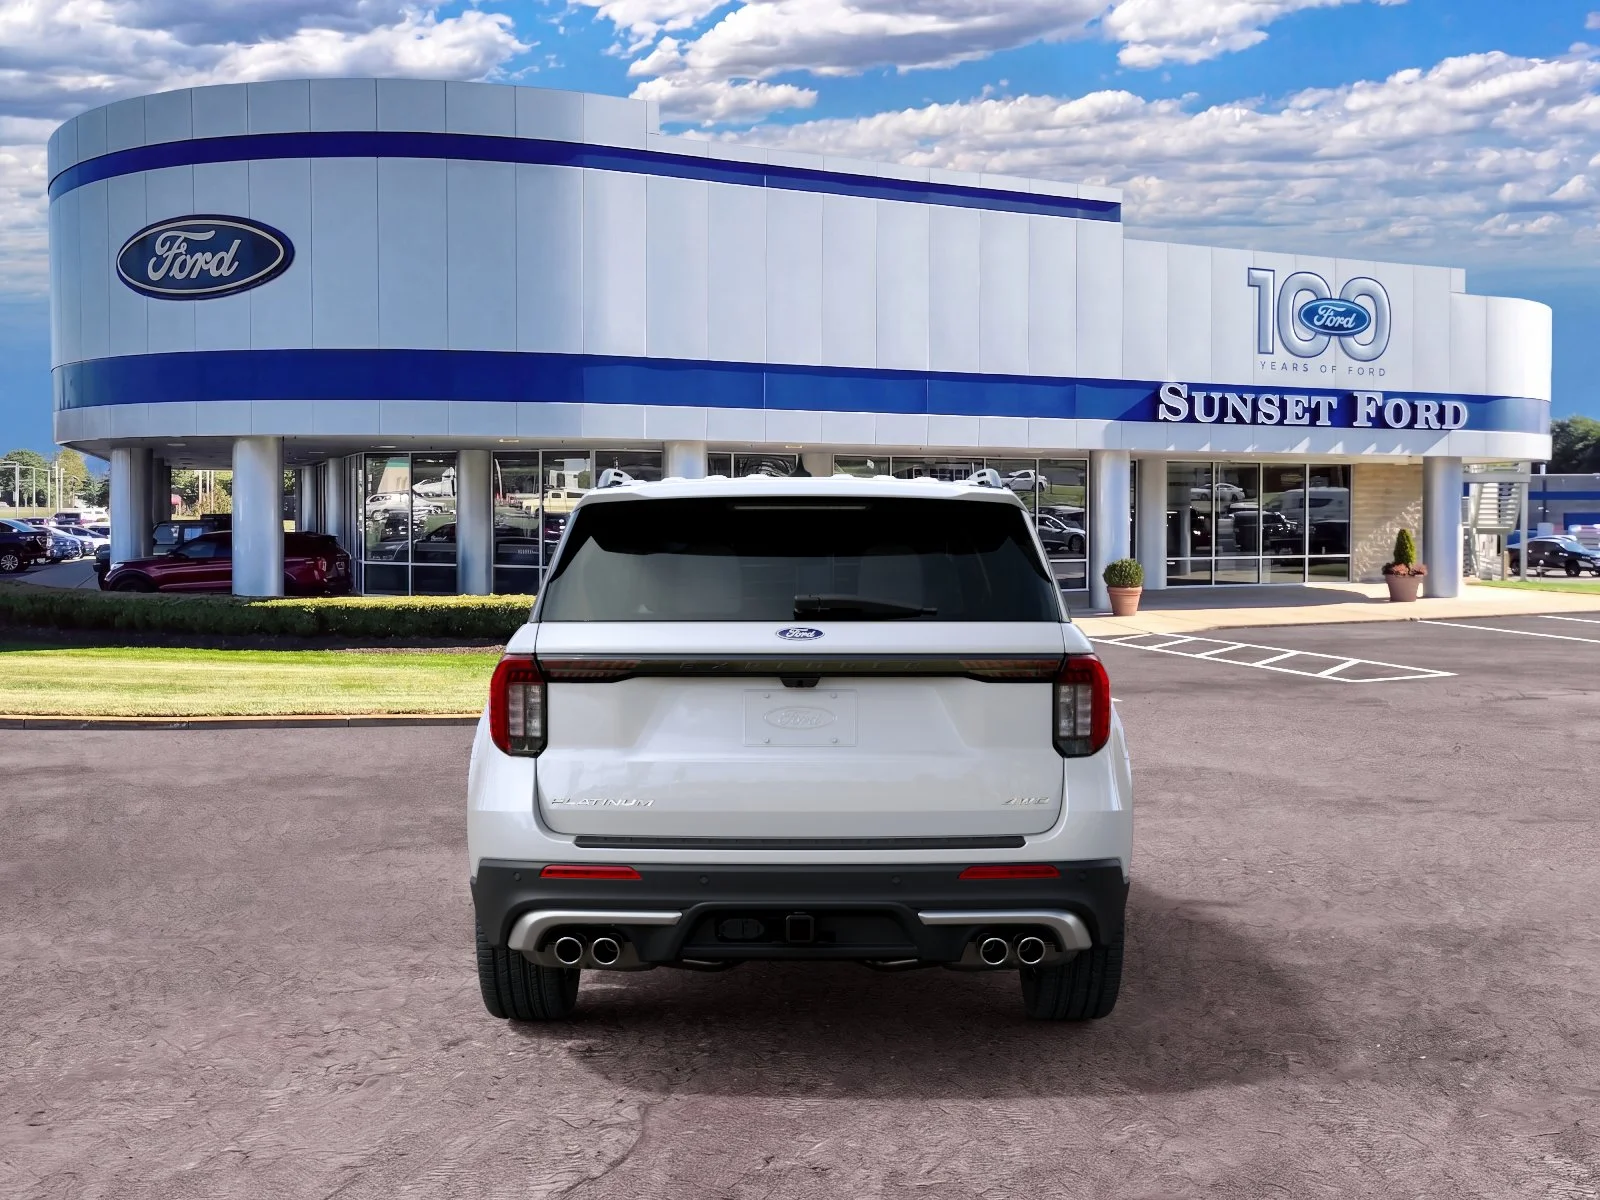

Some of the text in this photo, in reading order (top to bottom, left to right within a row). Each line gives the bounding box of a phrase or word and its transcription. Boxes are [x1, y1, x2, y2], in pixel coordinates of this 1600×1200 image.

[148, 230, 241, 281] Ford
[1248, 267, 1391, 362] 100
[1314, 305, 1356, 328] Ford
[1260, 361, 1386, 377] YEARS OF FORD
[785, 627, 816, 639] Ford
[778, 710, 822, 726] Ford
[551, 798, 655, 807] PLATINUM
